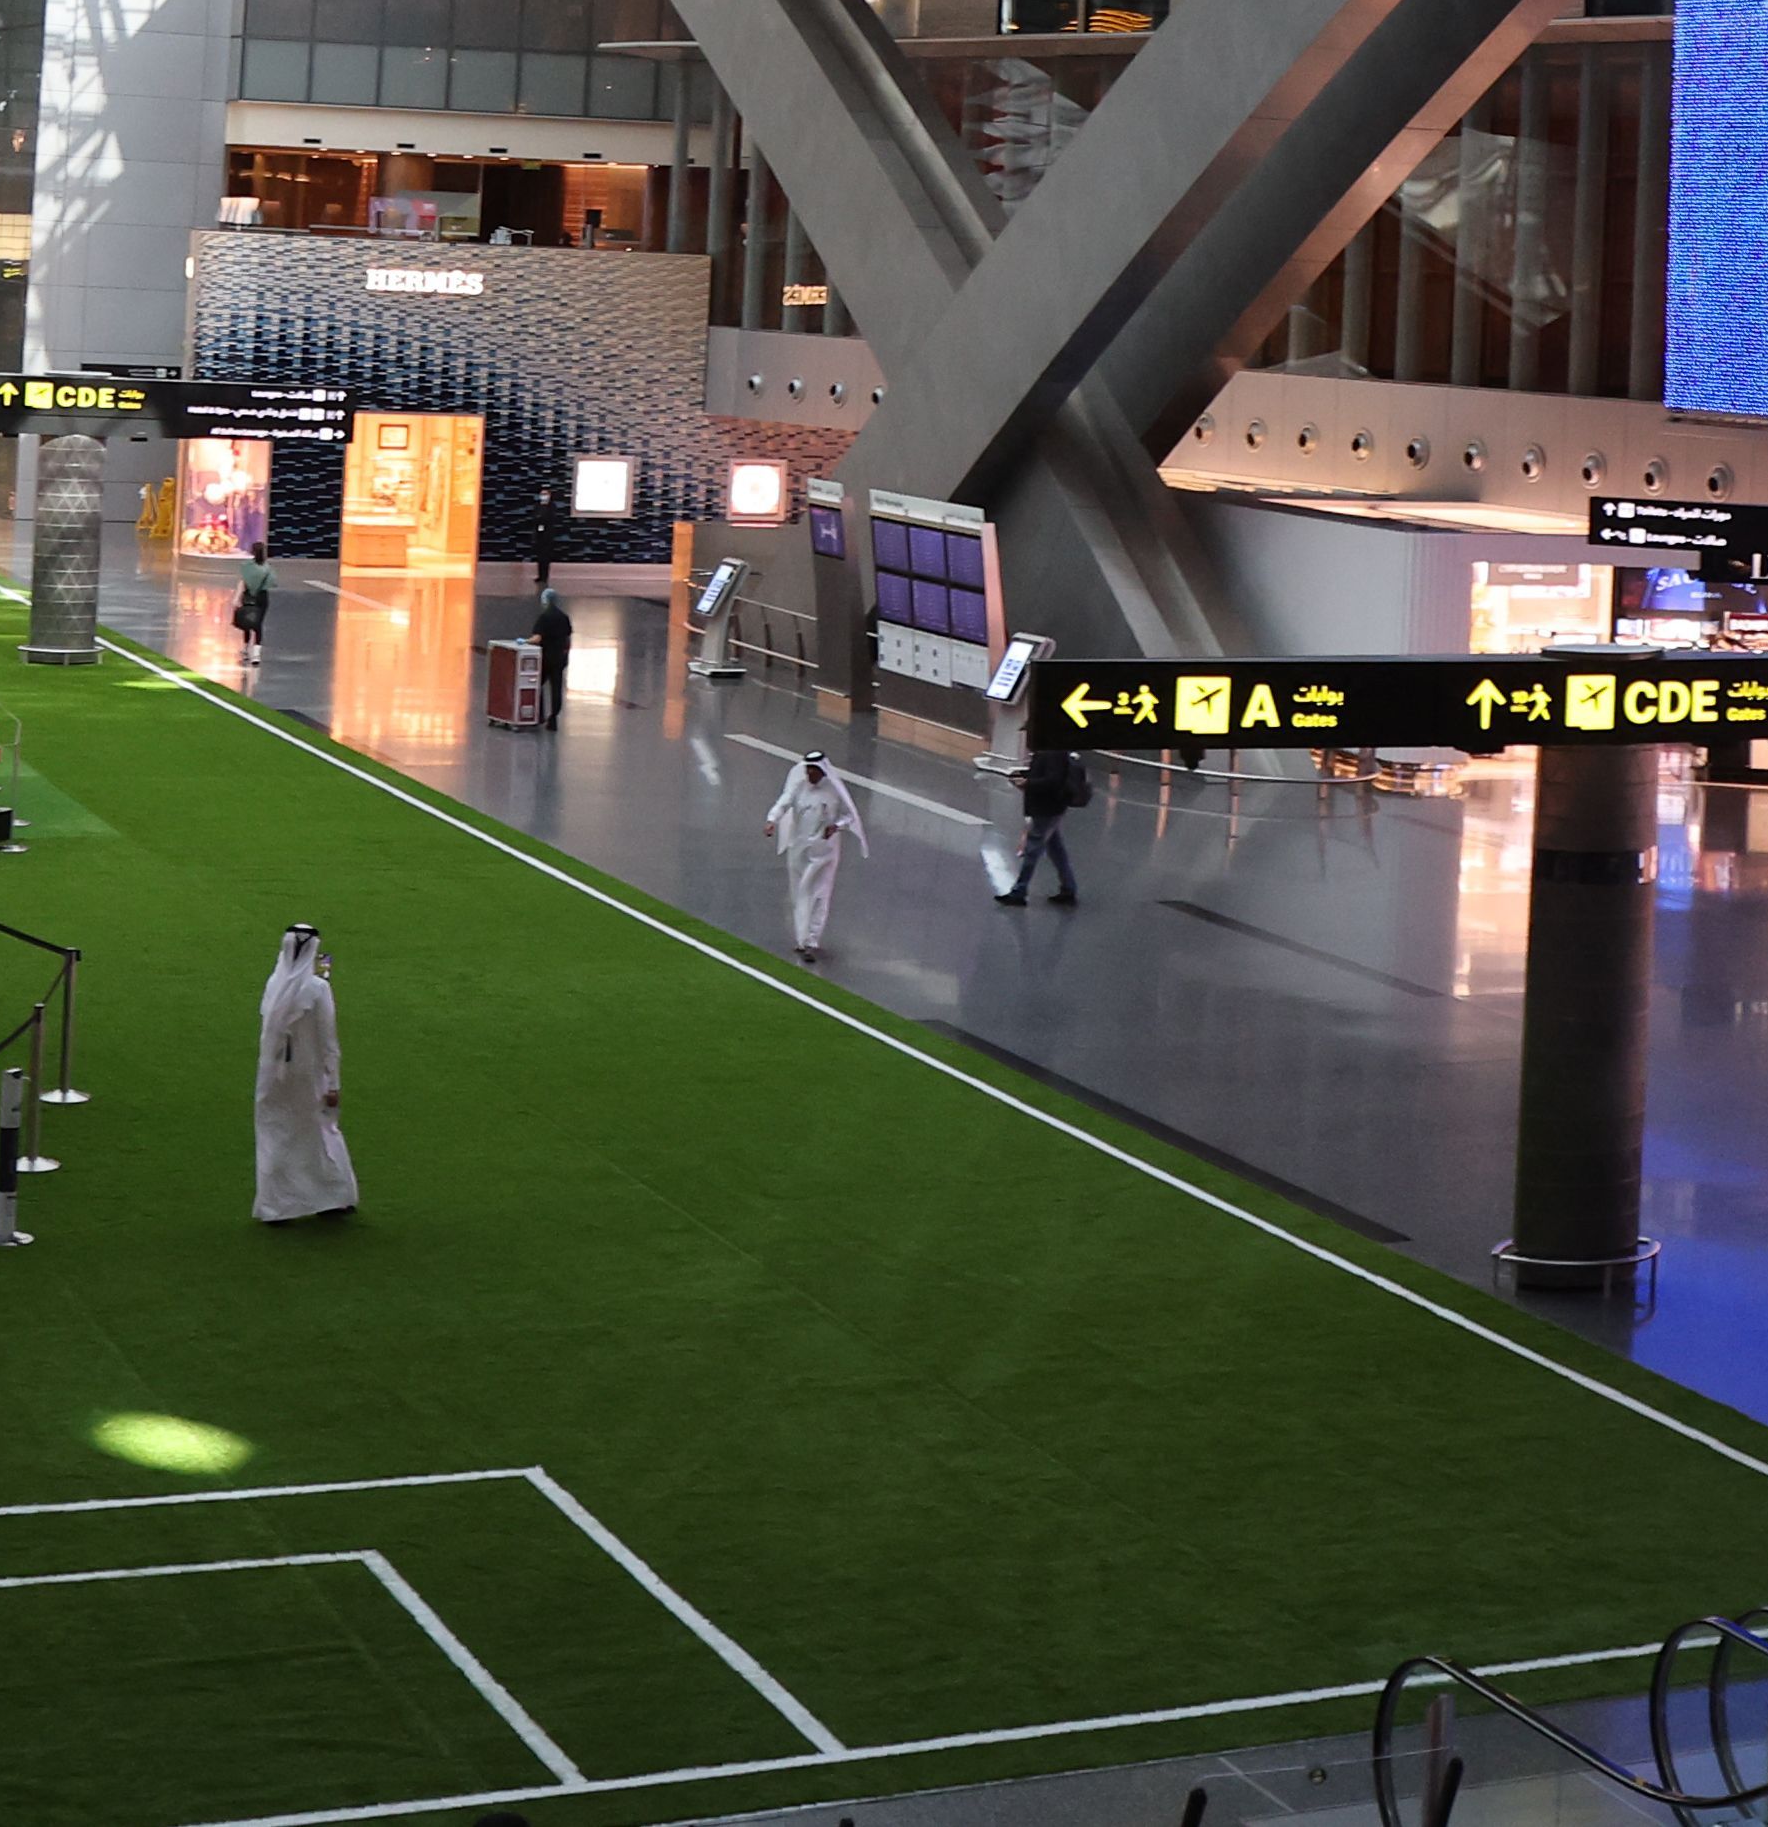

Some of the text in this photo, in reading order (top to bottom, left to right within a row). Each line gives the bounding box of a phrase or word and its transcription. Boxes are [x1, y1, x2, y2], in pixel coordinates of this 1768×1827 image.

[56, 385, 116, 409] CDE
[1117, 691, 1130, 706] 3
[1240, 683, 1281, 728] A
[1292, 684, 1345, 706] بوابات
[1623, 679, 1720, 724] CDE
[1292, 711, 1338, 728] Gates
[1726, 706, 1766, 721] Gates
